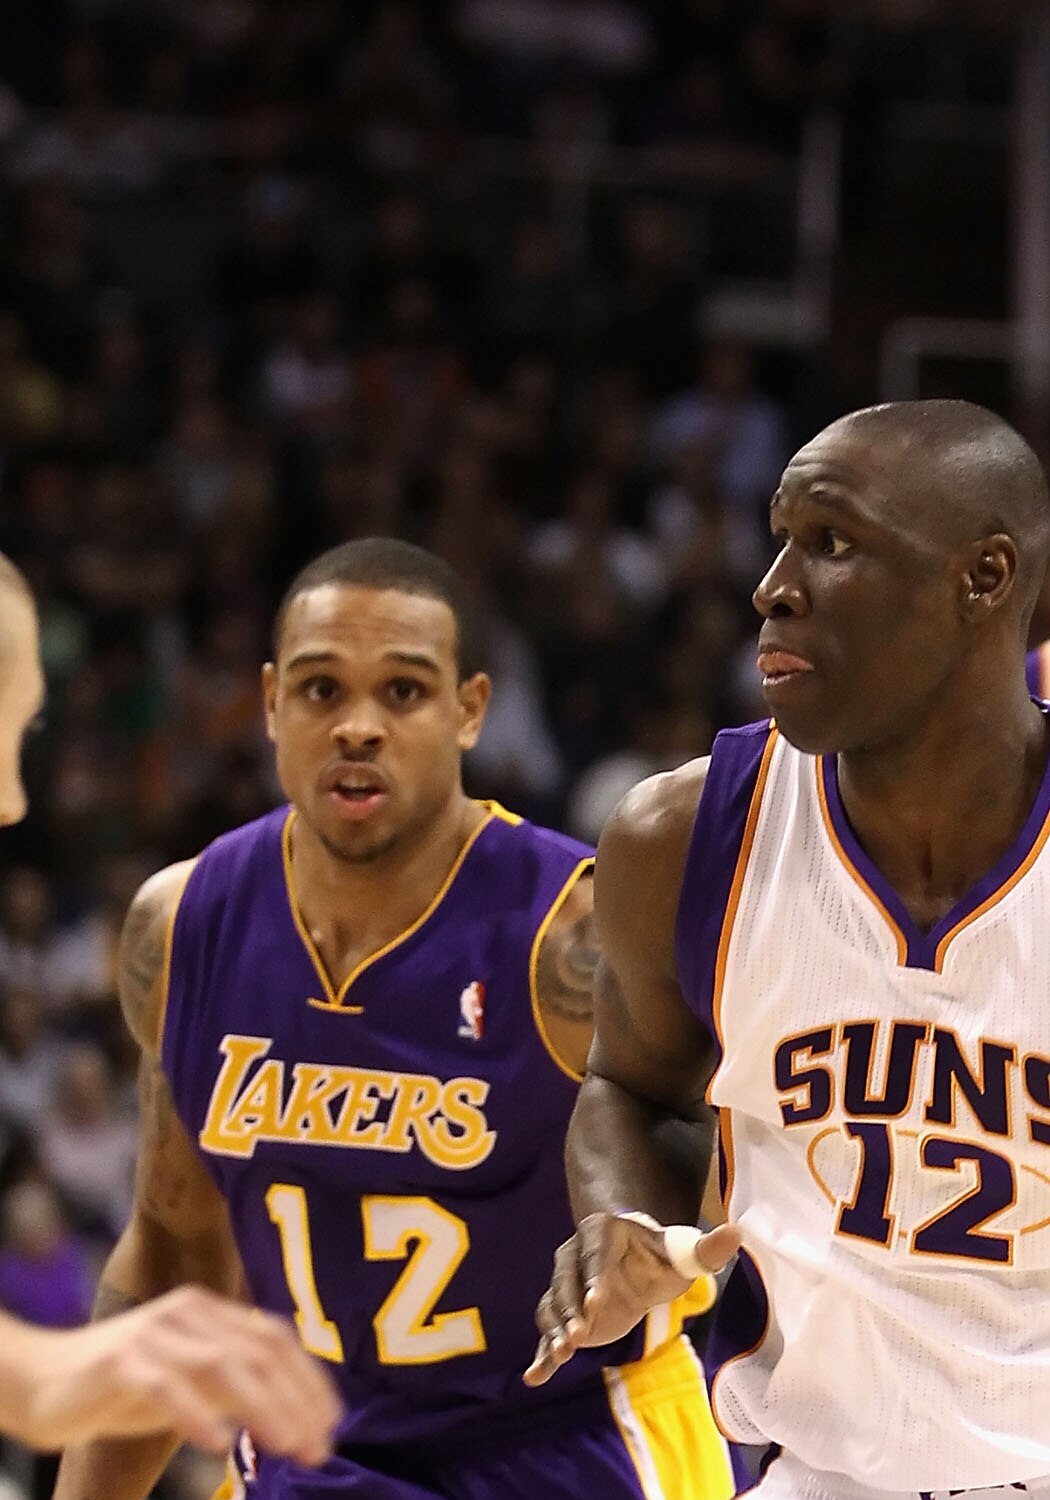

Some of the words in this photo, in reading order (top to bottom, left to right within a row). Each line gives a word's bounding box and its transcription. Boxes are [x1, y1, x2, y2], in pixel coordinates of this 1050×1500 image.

[200, 1034, 497, 1169] LAKERS
[834, 1119, 1015, 1266] 12
[265, 1182, 487, 1366] 12
